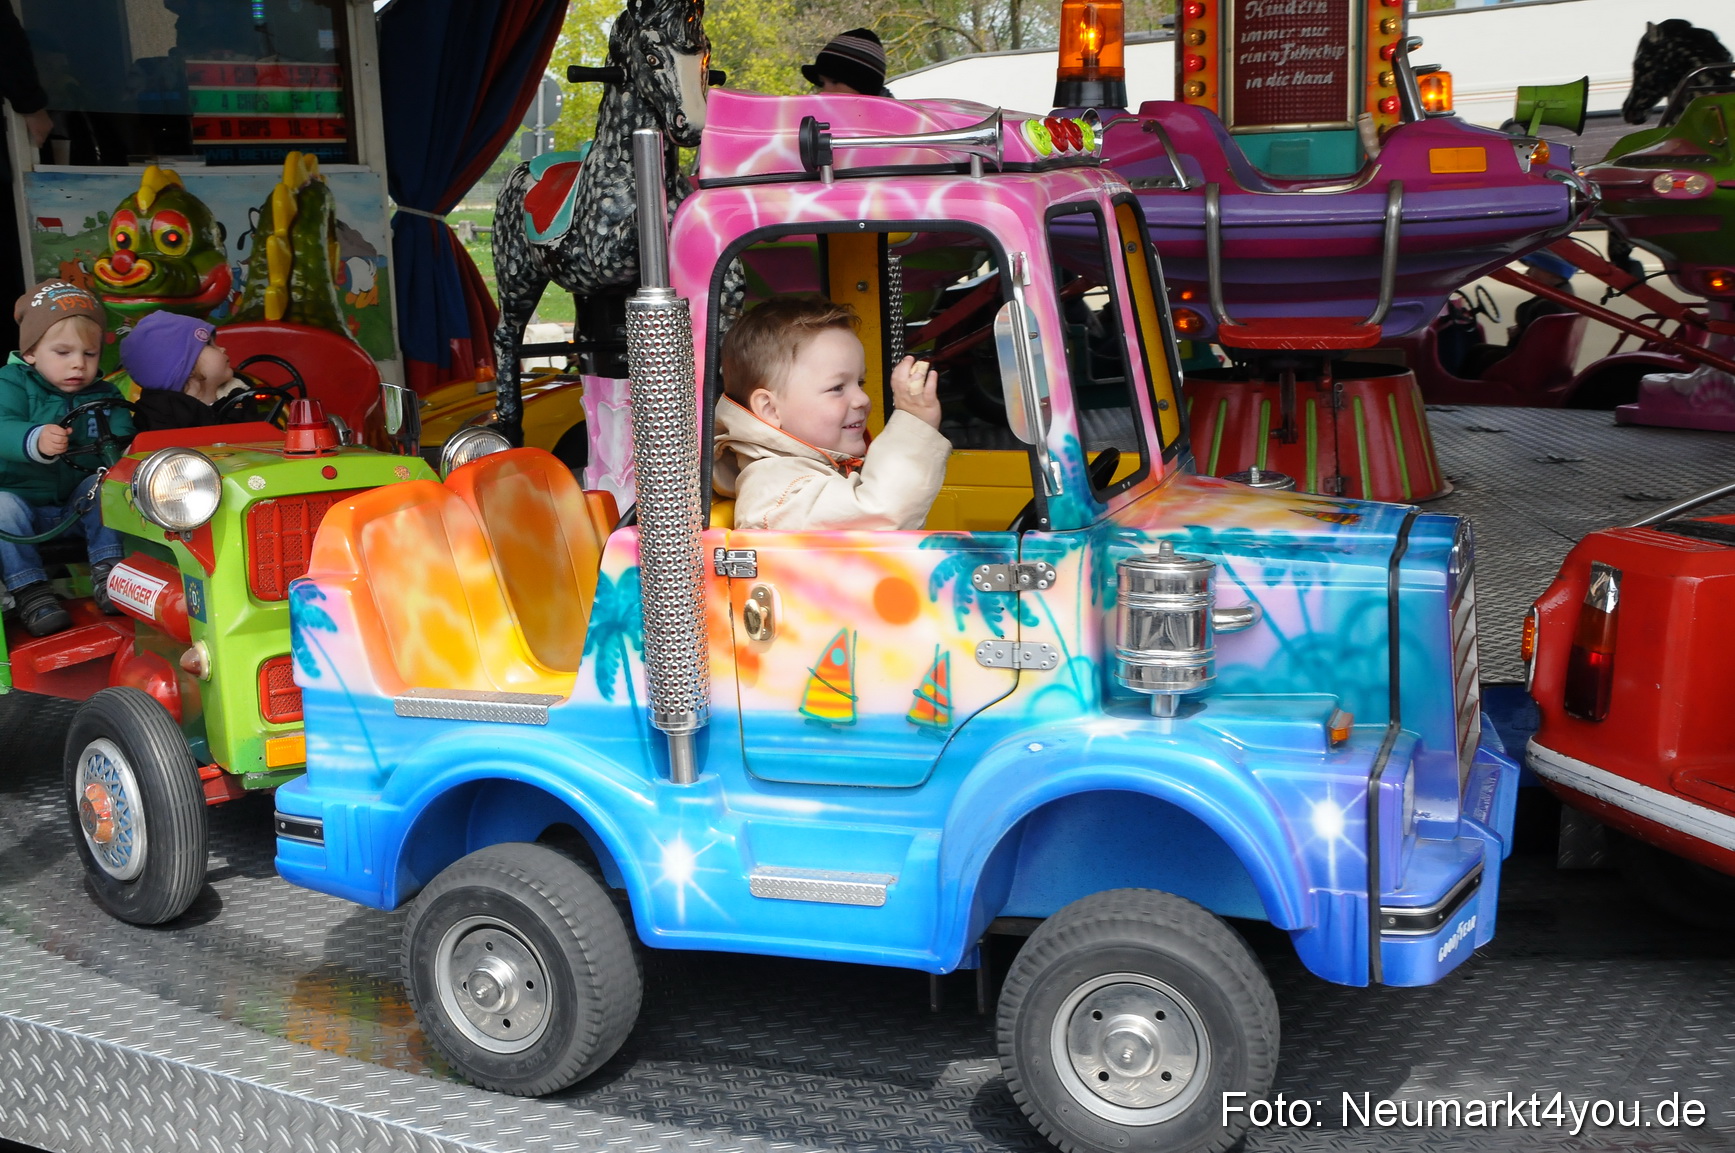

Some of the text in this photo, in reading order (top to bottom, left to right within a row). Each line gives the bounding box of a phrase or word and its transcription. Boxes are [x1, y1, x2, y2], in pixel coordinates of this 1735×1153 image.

[1245, 0, 1328, 20] Kindern
[1241, 25, 1331, 43] immer nur
[1240, 46, 1280, 65] einen
[1245, 70, 1335, 90] in die Hand
[236, 93, 270, 111] CHIPS
[219, 119, 233, 137] 10
[238, 119, 272, 137] CHIPS
[205, 148, 234, 160] WIR
[109, 574, 158, 608] ANFÄNGER!
